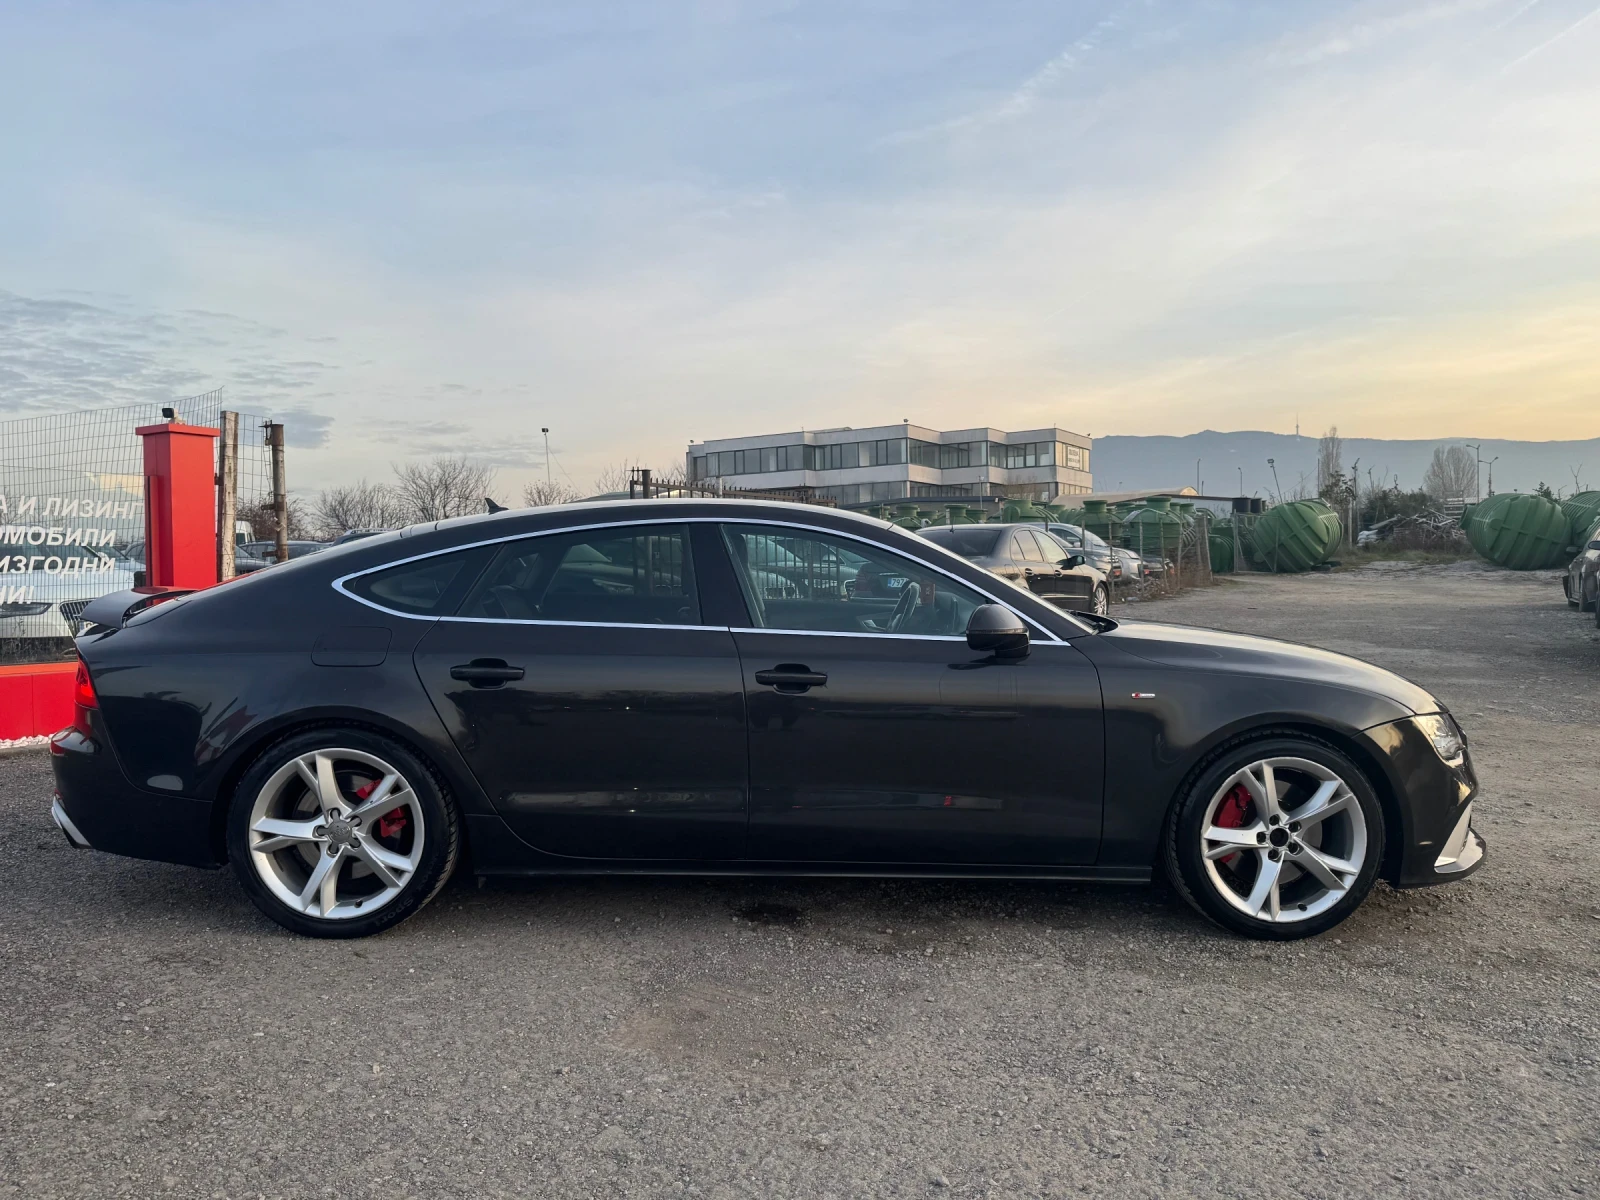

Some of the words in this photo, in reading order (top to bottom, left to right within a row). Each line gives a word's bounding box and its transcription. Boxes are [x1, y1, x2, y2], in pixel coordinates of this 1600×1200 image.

[18, 495, 37, 515] И
[42, 497, 144, 519] ЛИЗИНГ
[0, 525, 116, 547] МОБИЛИ
